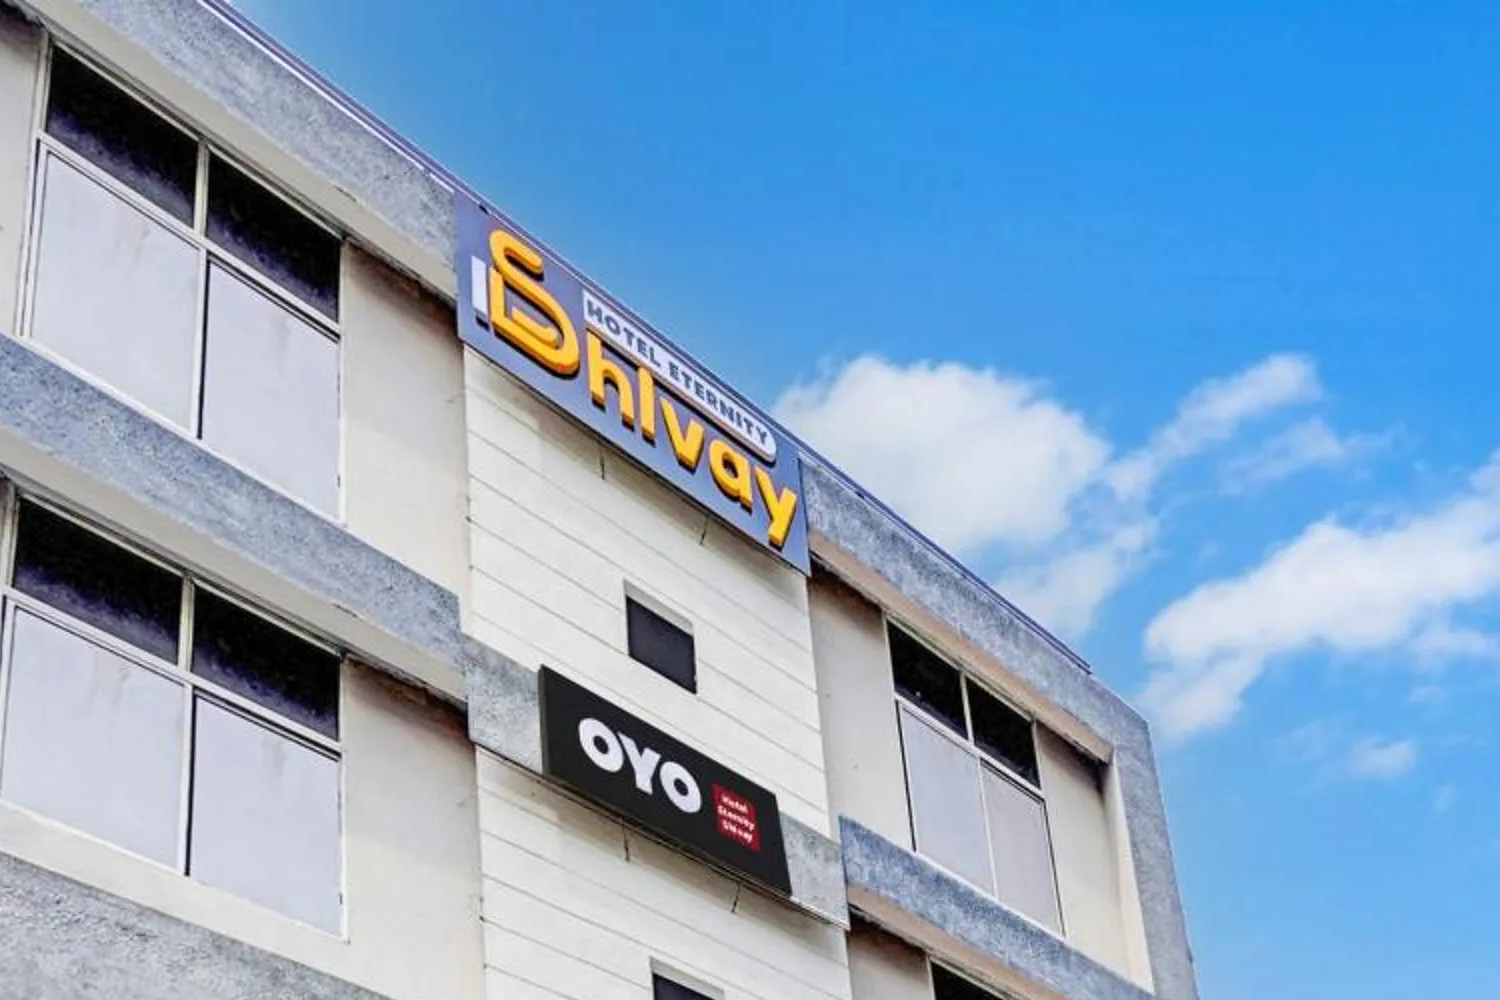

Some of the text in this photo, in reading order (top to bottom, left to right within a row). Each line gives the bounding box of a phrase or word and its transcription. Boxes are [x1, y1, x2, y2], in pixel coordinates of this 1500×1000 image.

[587, 299, 767, 445] HOTEL ETERNITY
[579, 717, 702, 814] OYO
